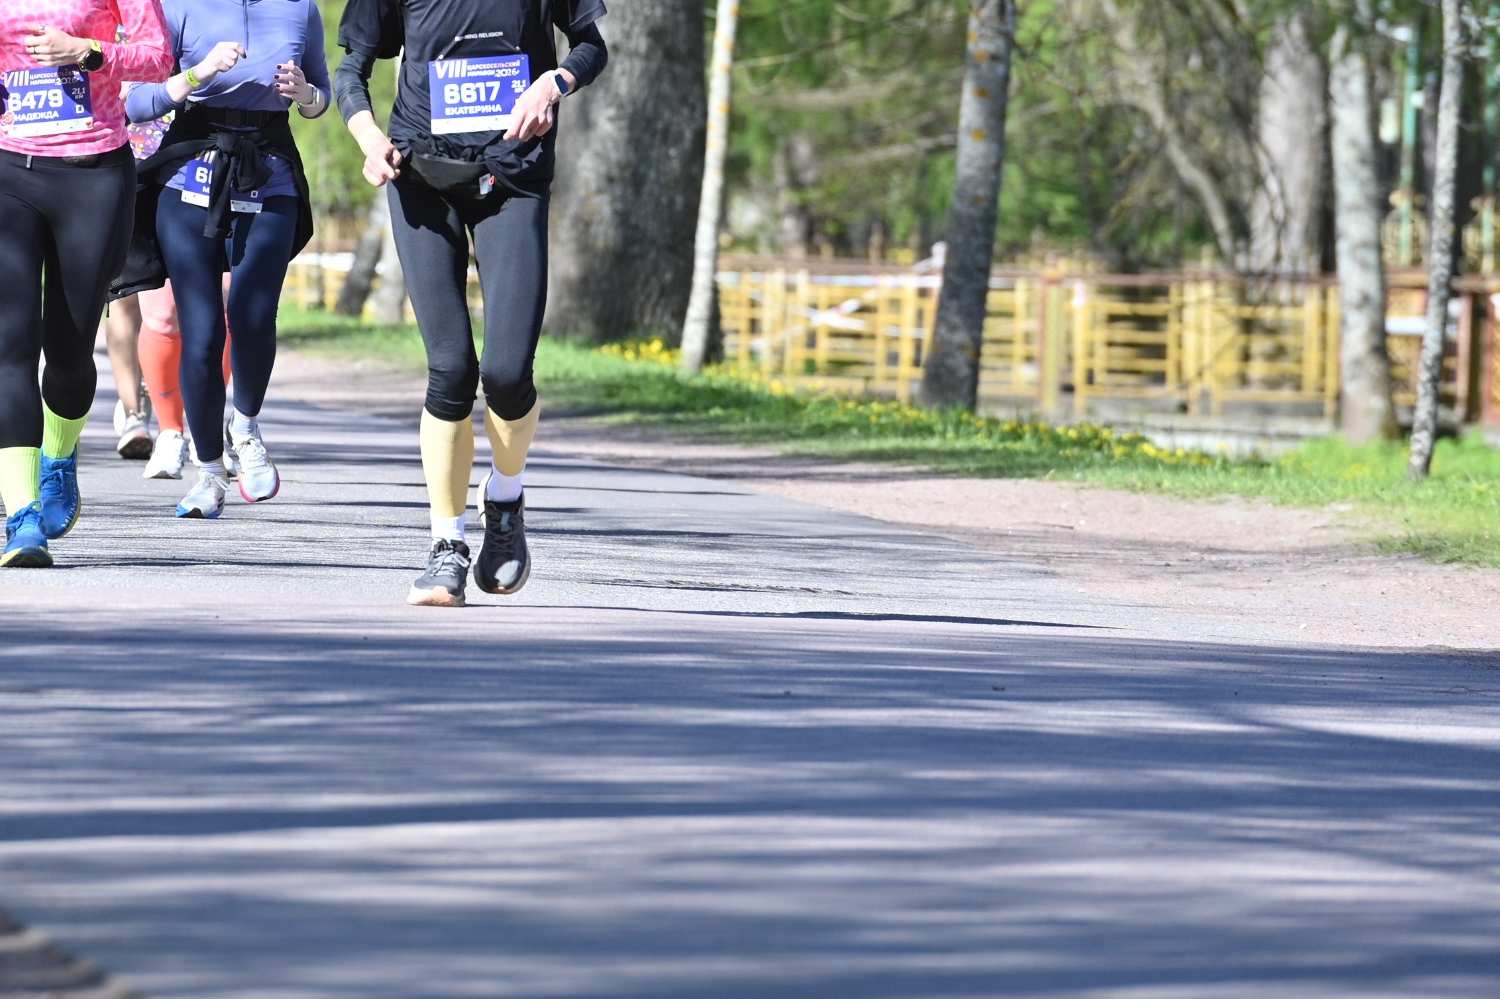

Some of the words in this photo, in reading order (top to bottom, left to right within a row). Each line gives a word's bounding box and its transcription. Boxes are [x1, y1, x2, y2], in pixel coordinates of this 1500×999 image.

[435, 60, 468, 79] VIII
[467, 60, 520, 70] ЦАРСКОСЕЛЬСКИЙ
[495, 68, 517, 77] 2026
[4, 70, 30, 88] VIII
[444, 81, 500, 104] 6617
[445, 104, 502, 115] ЕКАТЕРИНА
[15, 111, 59, 121] НАДЕЖДА
